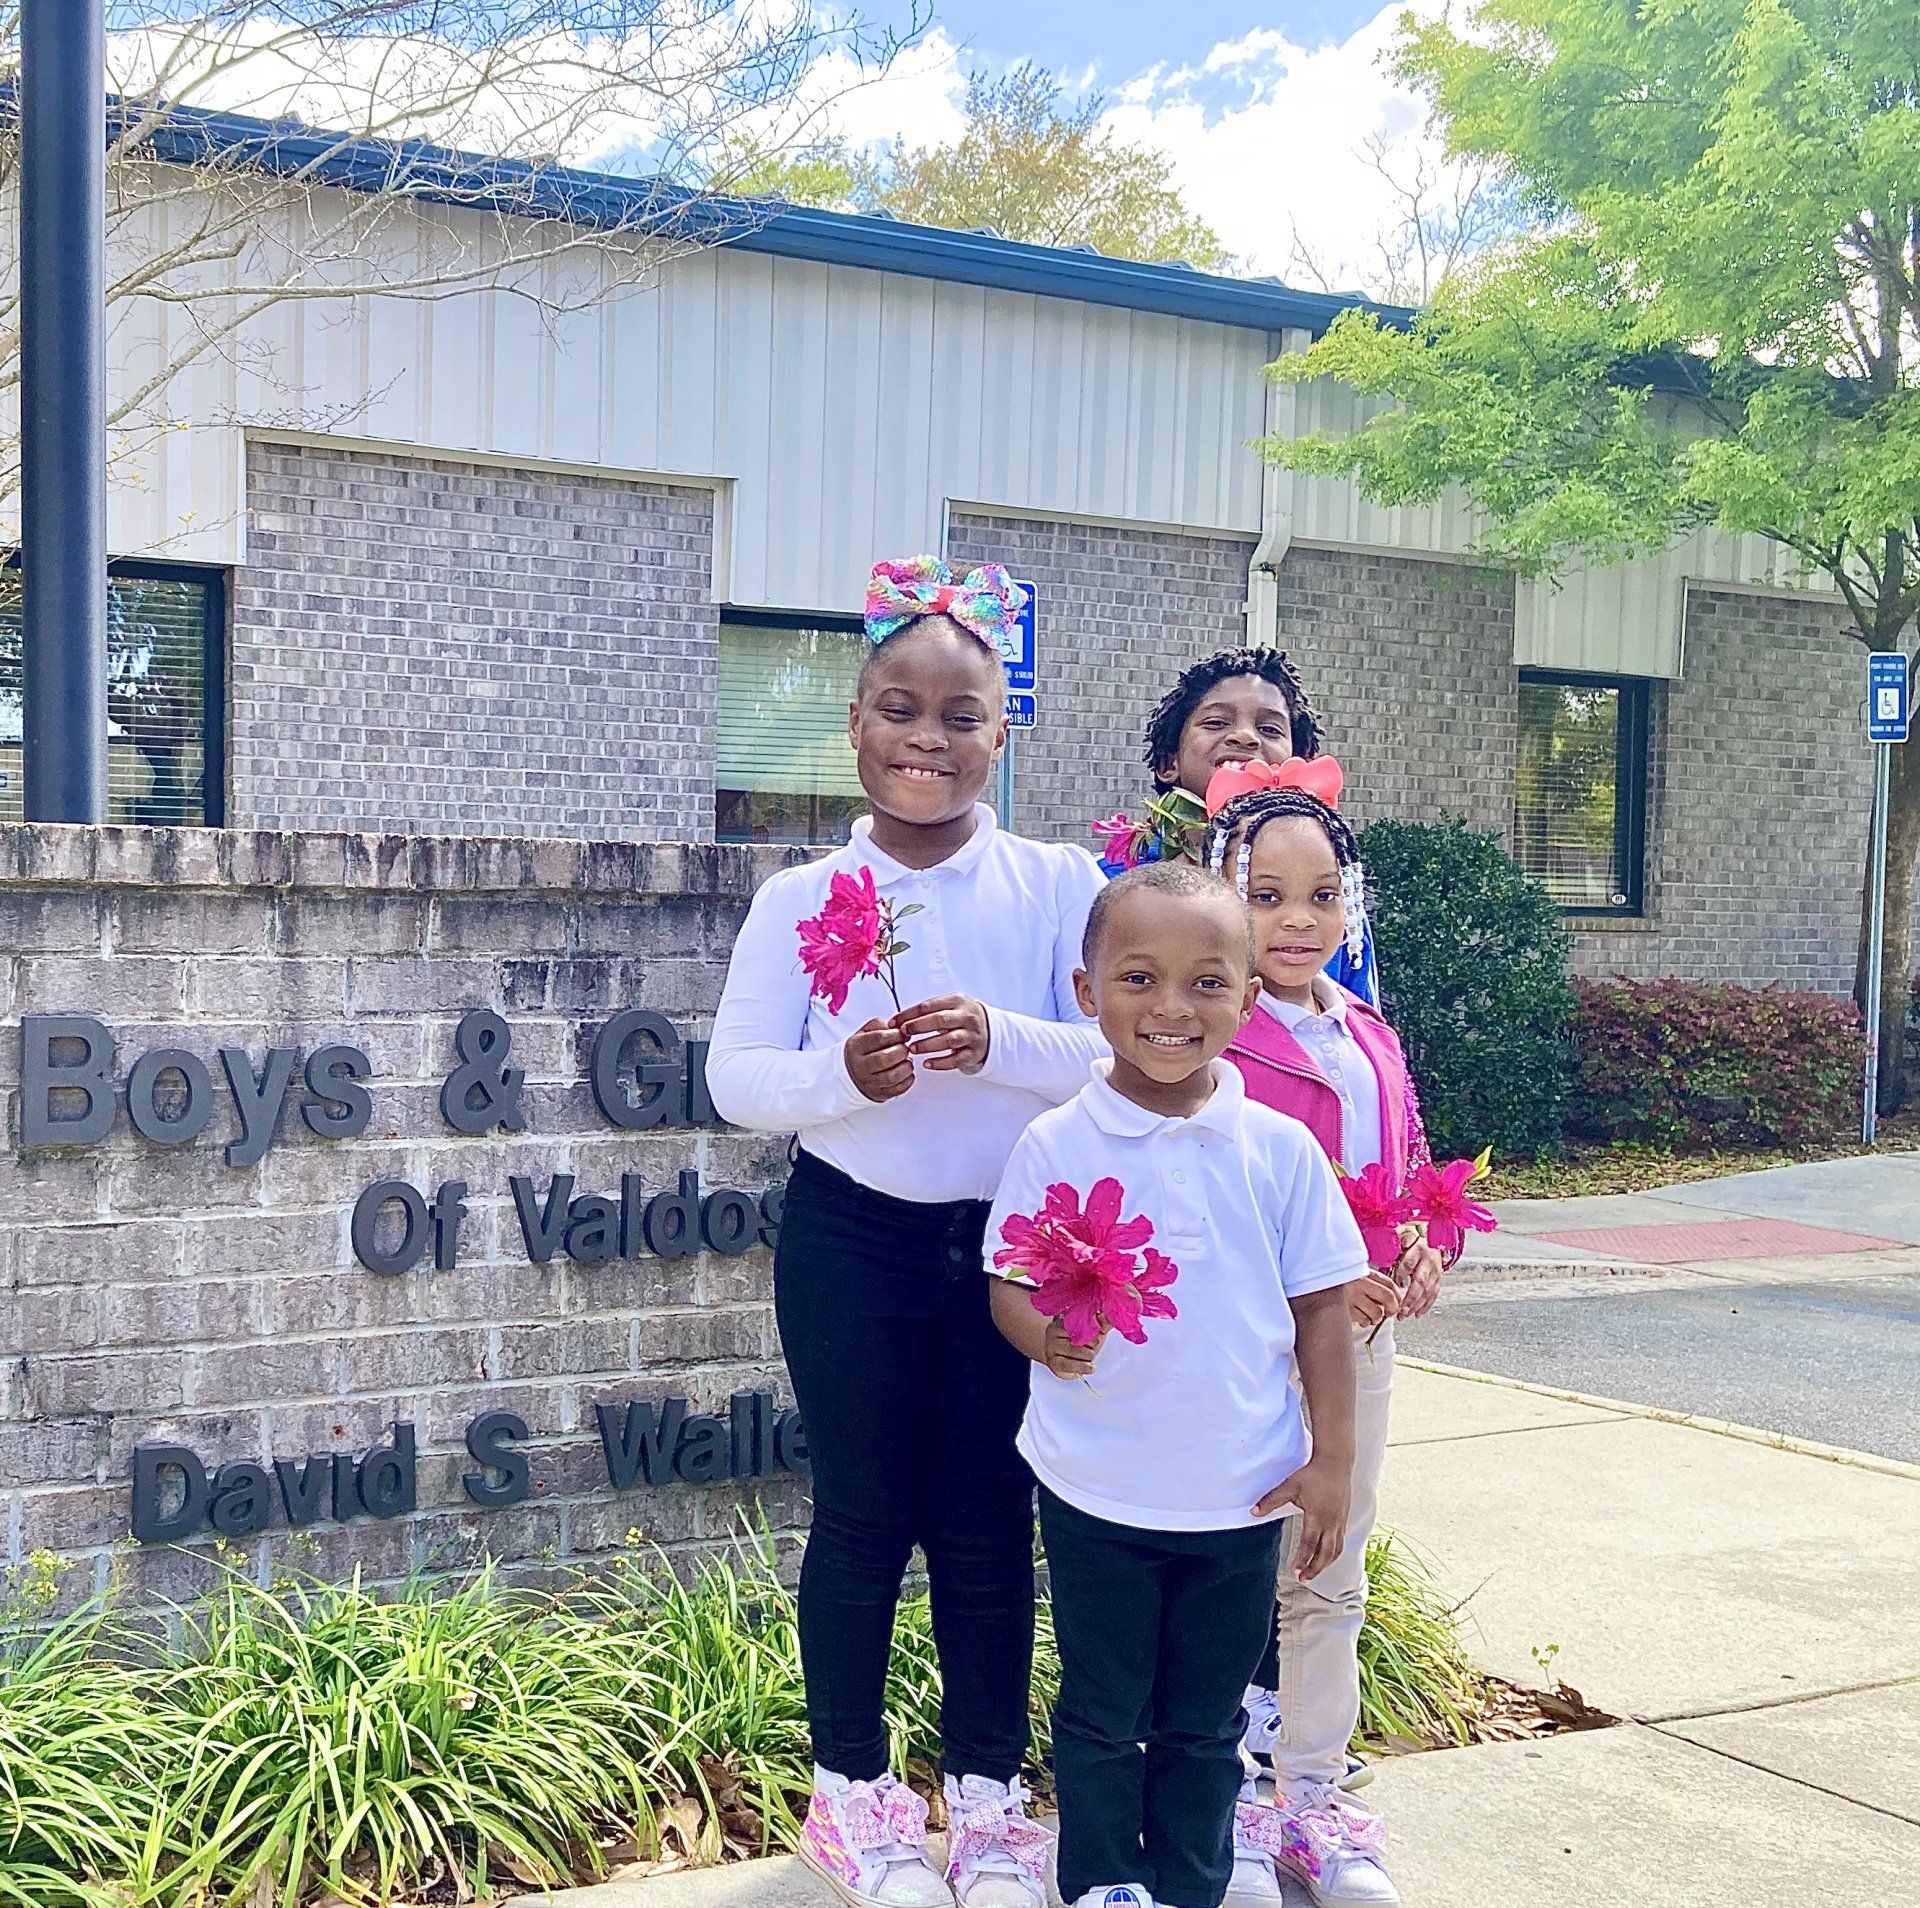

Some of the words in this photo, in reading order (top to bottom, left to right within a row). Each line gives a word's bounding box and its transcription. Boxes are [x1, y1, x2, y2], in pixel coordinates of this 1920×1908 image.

[20, 1014, 373, 1167] Boys
[440, 1009, 527, 1134] &
[351, 1180, 468, 1276] Of
[131, 1420, 417, 1541] David
[463, 1409, 530, 1506] S
